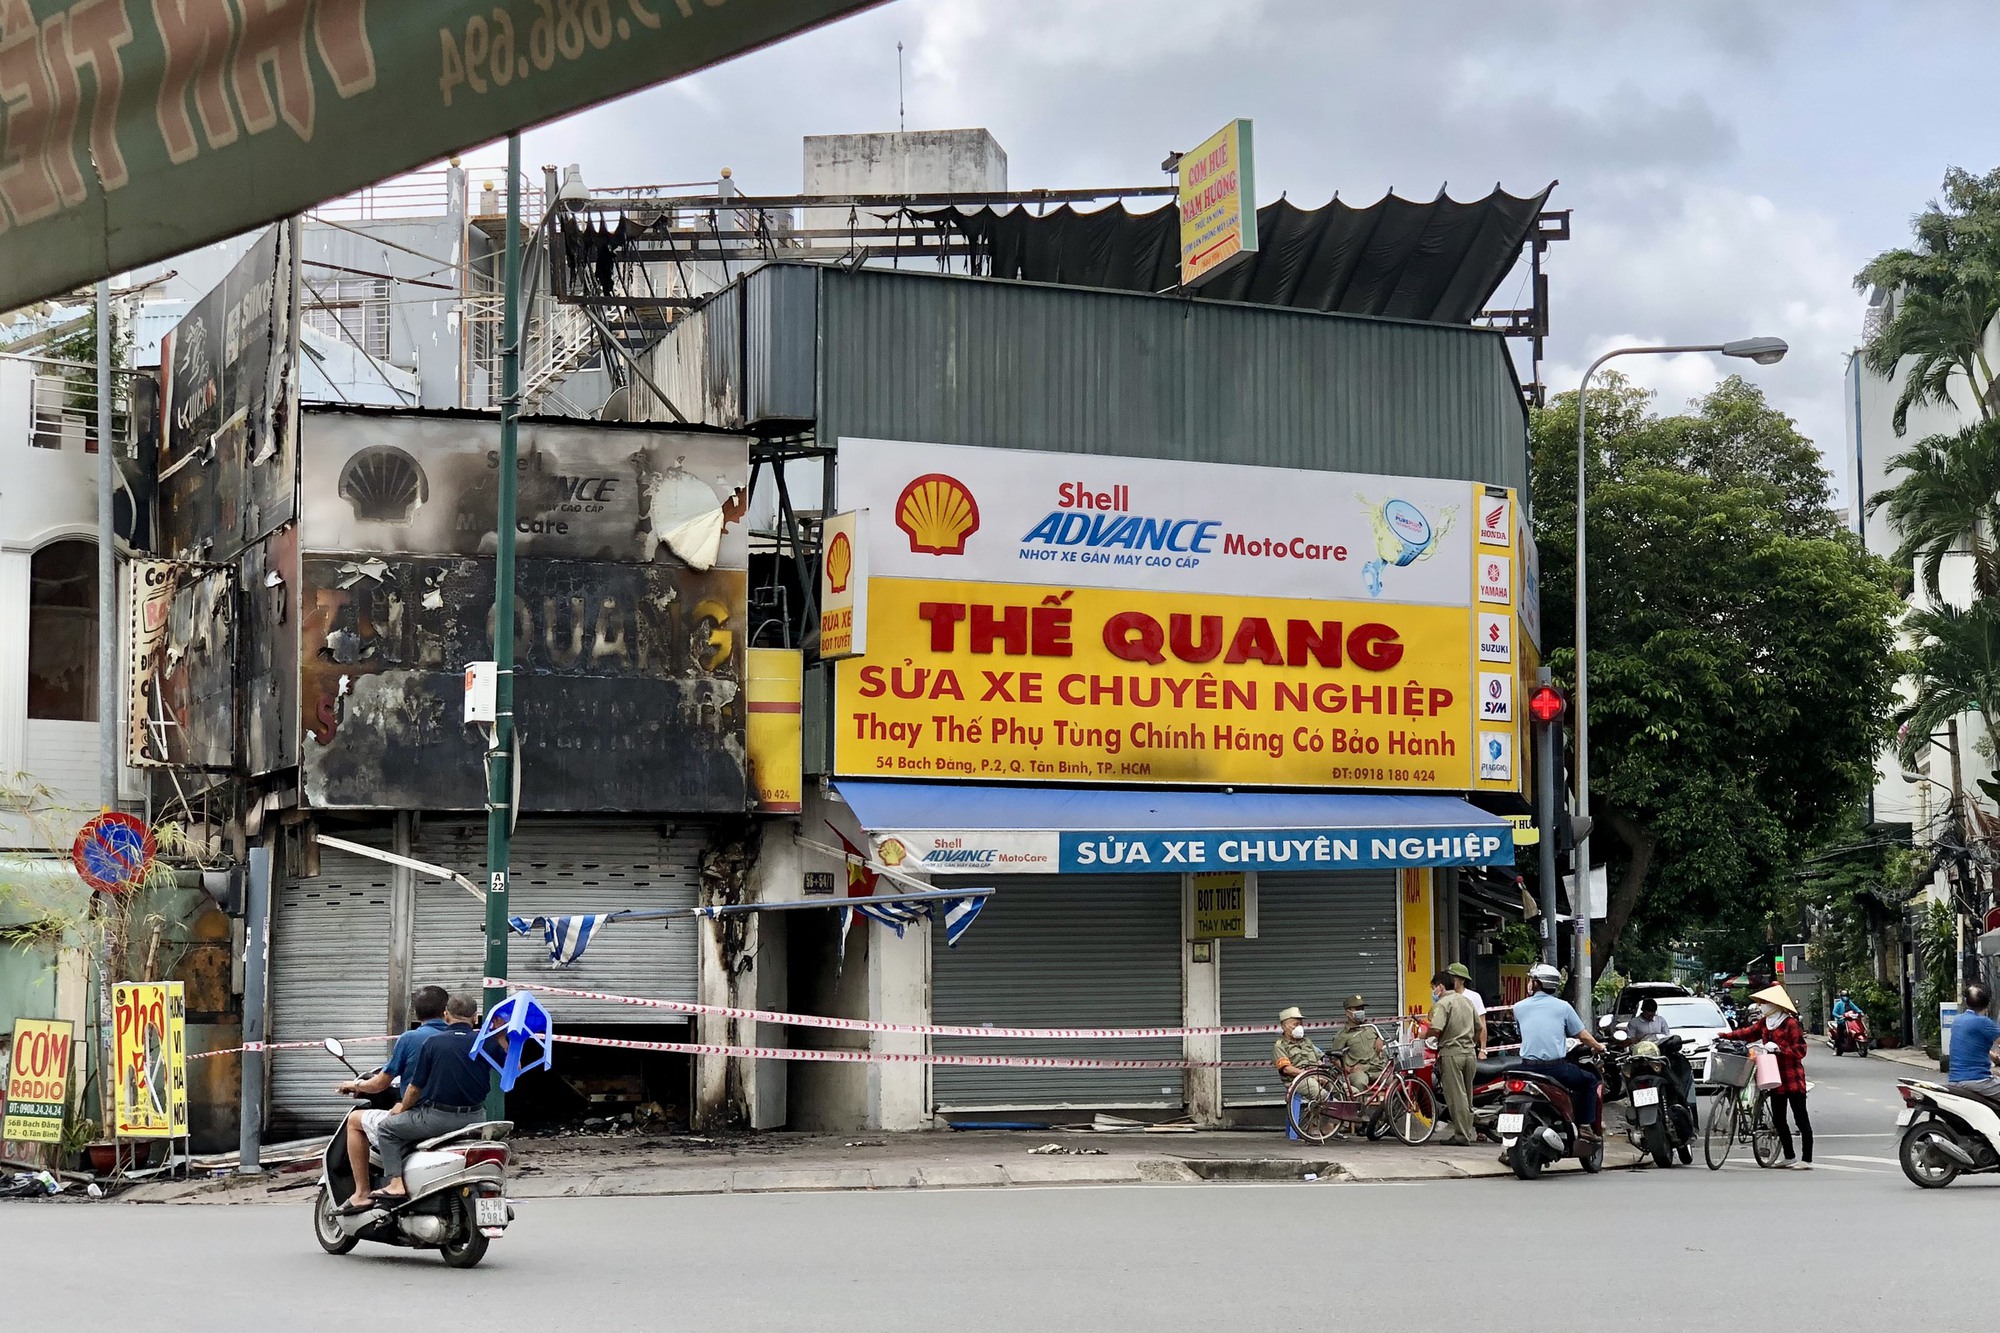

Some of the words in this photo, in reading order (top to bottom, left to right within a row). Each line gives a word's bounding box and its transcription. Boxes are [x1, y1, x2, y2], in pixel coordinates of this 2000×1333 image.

[1182, 193, 1202, 225] NAM
[1058, 482, 1129, 511] Shell
[1020, 511, 1222, 553] ADVANCE
[1481, 529, 1507, 540] HONDA
[1223, 533, 1348, 562] MotoCare
[1060, 551, 1077, 562] XE
[1145, 556, 1171, 568] CAO
[1480, 585, 1508, 598] YAMAHA
[841, 610, 851, 629] XE
[919, 590, 1074, 658] THẾ
[1103, 611, 1404, 672] QUANG
[1481, 643, 1508, 654] SUZUKI
[858, 658, 965, 700] SỬA
[980, 671, 1042, 703] XE
[1058, 672, 1256, 710] CHUYÊN
[1274, 680, 1453, 722] NGHIỆP
[1484, 702, 1507, 714] SYM
[853, 712, 922, 748] Thay
[932, 715, 983, 744] Thế
[992, 717, 1043, 750] Phụ
[1054, 720, 1121, 754] Tùng
[1131, 722, 1205, 750] Chính
[1214, 725, 1283, 758] Hãng
[1293, 727, 1323, 752] Có
[1332, 728, 1379, 754] Bảo
[1388, 731, 1455, 756] Hành
[876, 756, 893, 769] 54
[981, 760, 1006, 774] P.2,
[1010, 760, 1024, 773] Q.
[1030, 760, 1054, 773] Tân
[1097, 762, 1116, 774] TP.
[1121, 762, 1151, 775] HCM
[1354, 767, 1383, 780] 0918
[1388, 769, 1409, 781] 180
[1413, 769, 1435, 781] 424
[934, 838, 962, 848] Shell
[1077, 835, 1151, 865] SỬA
[1162, 841, 1206, 863] XE
[1218, 834, 1358, 863] CHUYÊN
[1371, 833, 1500, 862] NGHIỆP
[922, 849, 998, 862] ADVANCE
[998, 853, 1048, 863] MotoCare
[492, 883, 504, 891] 22
[494, 873, 501, 882] A
[1198, 889, 1214, 916] BỌT
[1216, 879, 1241, 910] TUYẾT
[1198, 919, 1219, 933] THAY
[1407, 937, 1416, 973] XE
[15, 1024, 69, 1078] CƠM
[11, 1079, 64, 1100] RADIO
